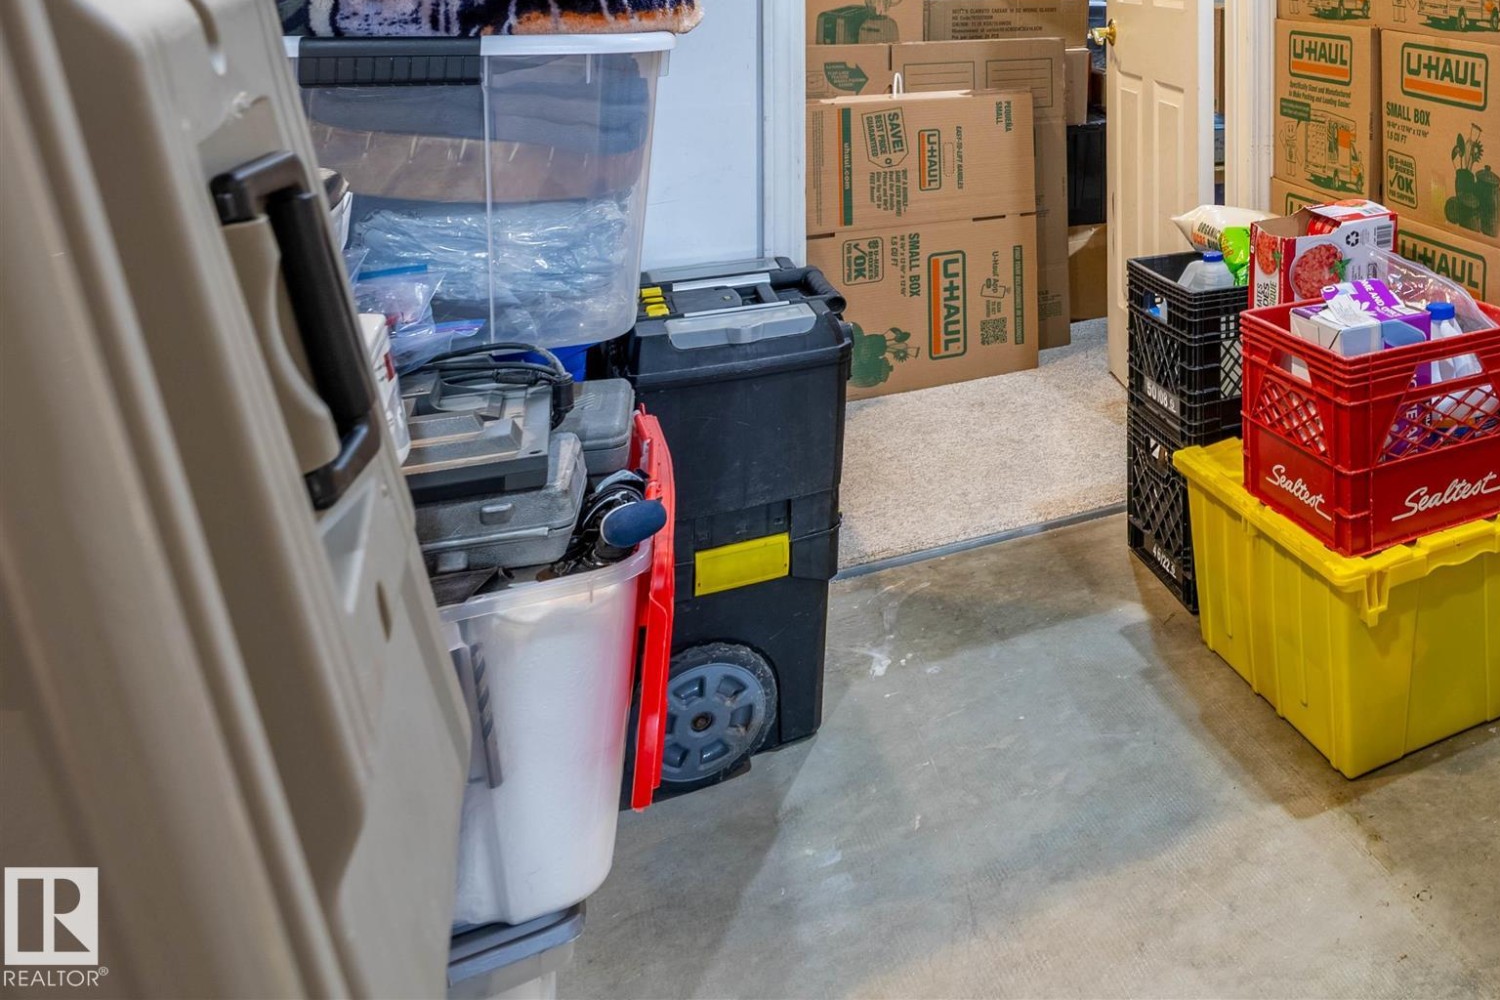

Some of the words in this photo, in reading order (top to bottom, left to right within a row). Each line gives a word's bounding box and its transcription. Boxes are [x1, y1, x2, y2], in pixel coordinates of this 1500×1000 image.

[1293, 38, 1347, 66] U-HAUL
[1407, 52, 1481, 87] U-HAUL
[874, 115, 884, 130] BEST
[1386, 101, 1411, 122] SMALL
[1414, 109, 1430, 127] BOX
[877, 132, 887, 155] PRICE
[888, 112, 904, 154] SAVE!
[843, 142, 851, 190] uhaul.com
[927, 133, 938, 186] U-HAUL
[1397, 177, 1414, 195] OK
[891, 259, 898, 267] FT
[908, 233, 920, 271] SMALL
[853, 255, 867, 281] OK
[909, 275, 921, 297] BOX
[991, 278, 999, 294] App
[943, 258, 961, 351] U-HAUL
[1265, 464, 1332, 522] Sealtest
